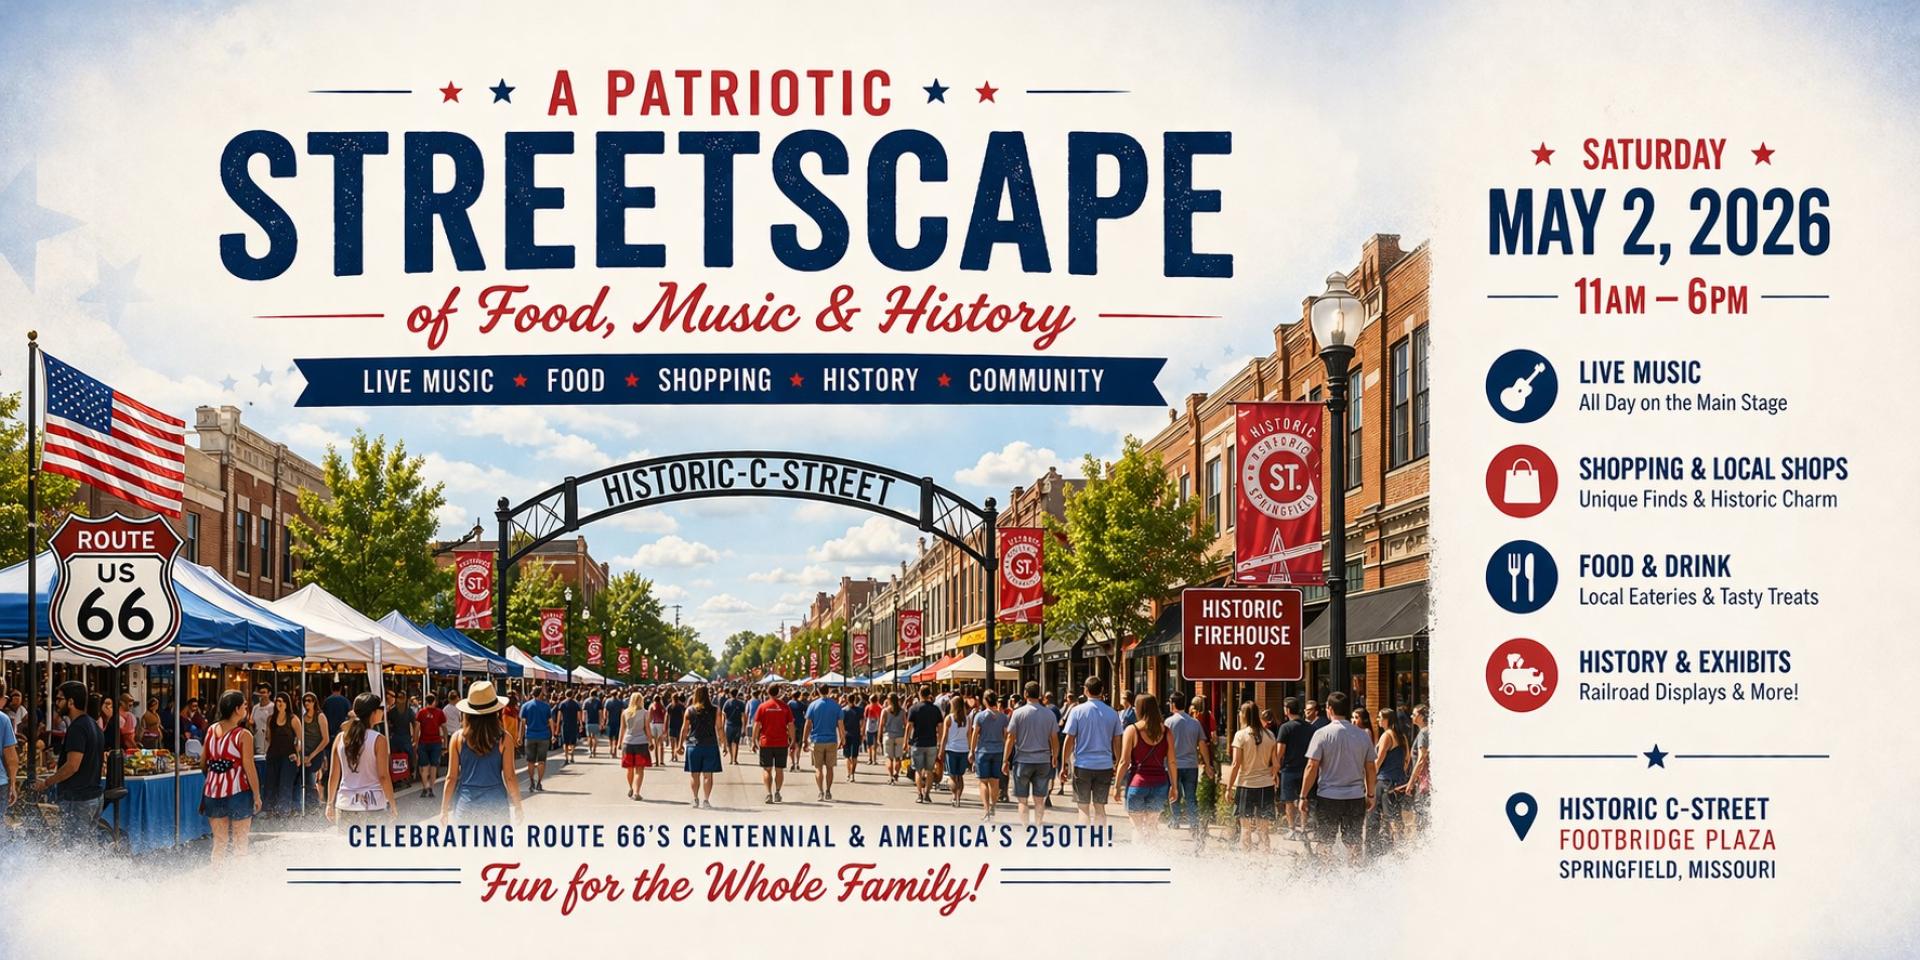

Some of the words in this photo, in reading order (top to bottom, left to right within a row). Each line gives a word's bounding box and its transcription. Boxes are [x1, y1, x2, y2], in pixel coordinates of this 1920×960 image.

[1250, 418, 1317, 438] HISTORIC
[602, 458, 895, 506] HISTORIC-C-STREET
[1270, 463, 1302, 491] ST.
[79, 531, 155, 549] ROUTE
[98, 563, 134, 583] US
[1015, 559, 1033, 576] ST.
[467, 577, 485, 590] ST.
[77, 587, 154, 641] 66
[1203, 600, 1282, 618] HISTORIC
[1195, 626, 1290, 645] FIREHOUSE
[1220, 652, 1247, 670] No.
[1255, 652, 1264, 670] 2
